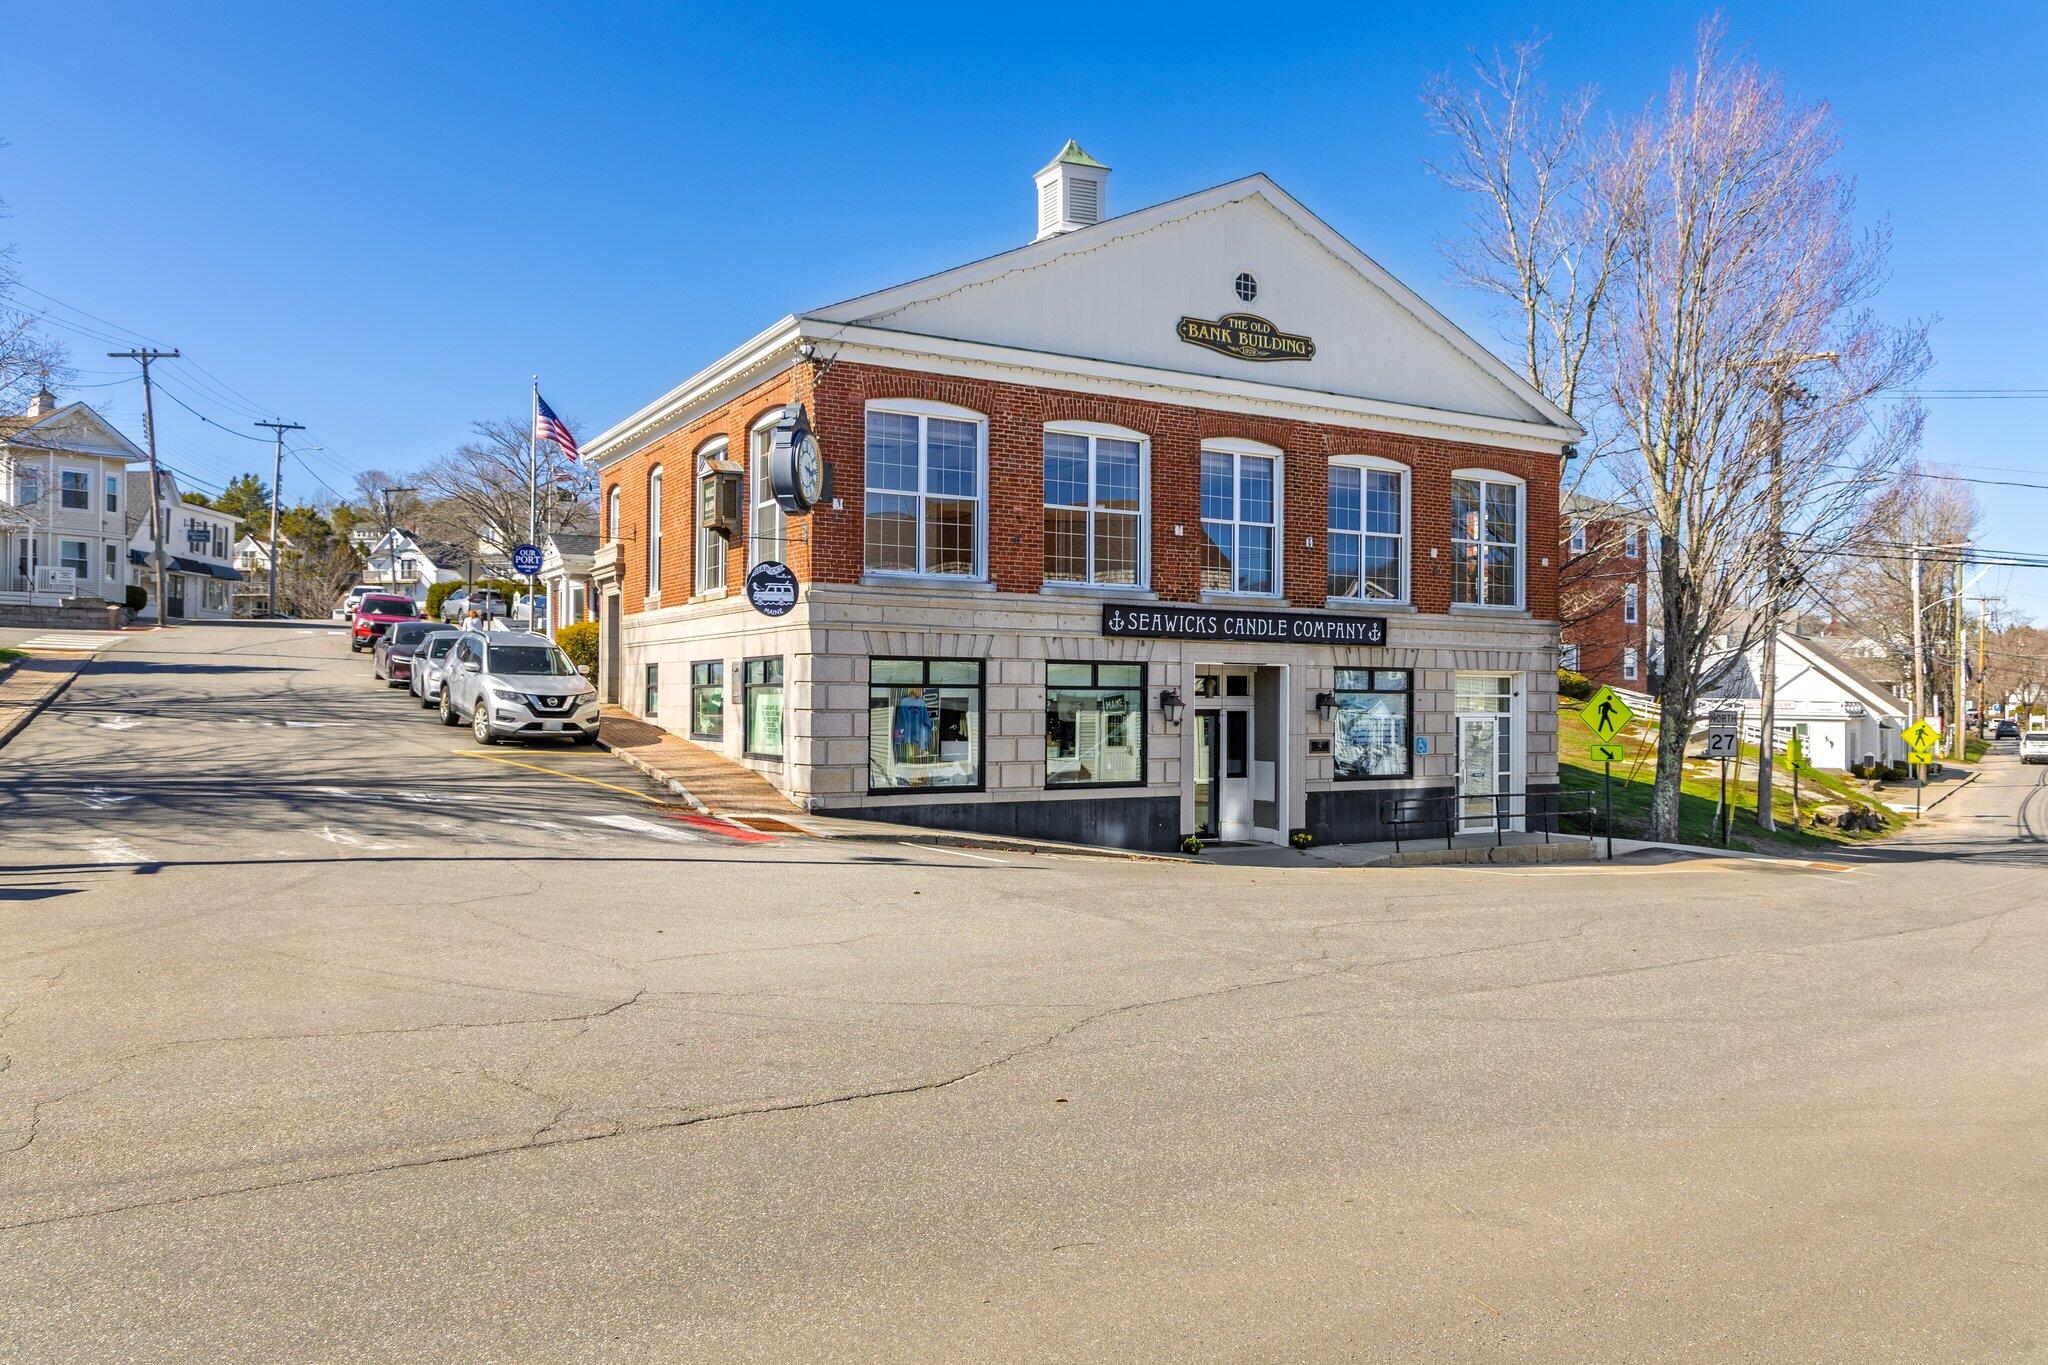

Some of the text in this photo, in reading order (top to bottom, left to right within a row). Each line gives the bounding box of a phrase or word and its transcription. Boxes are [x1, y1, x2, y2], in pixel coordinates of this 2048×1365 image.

[1228, 318, 1271, 334] THE OLD
[1188, 323, 1306, 354] BANK BUILDING
[515, 555, 540, 564] PORT
[1128, 612, 1367, 640] SEAWICKS CANDLE COMPANY
[1710, 713, 1737, 723] NORTH
[1712, 734, 1735, 750] 27
